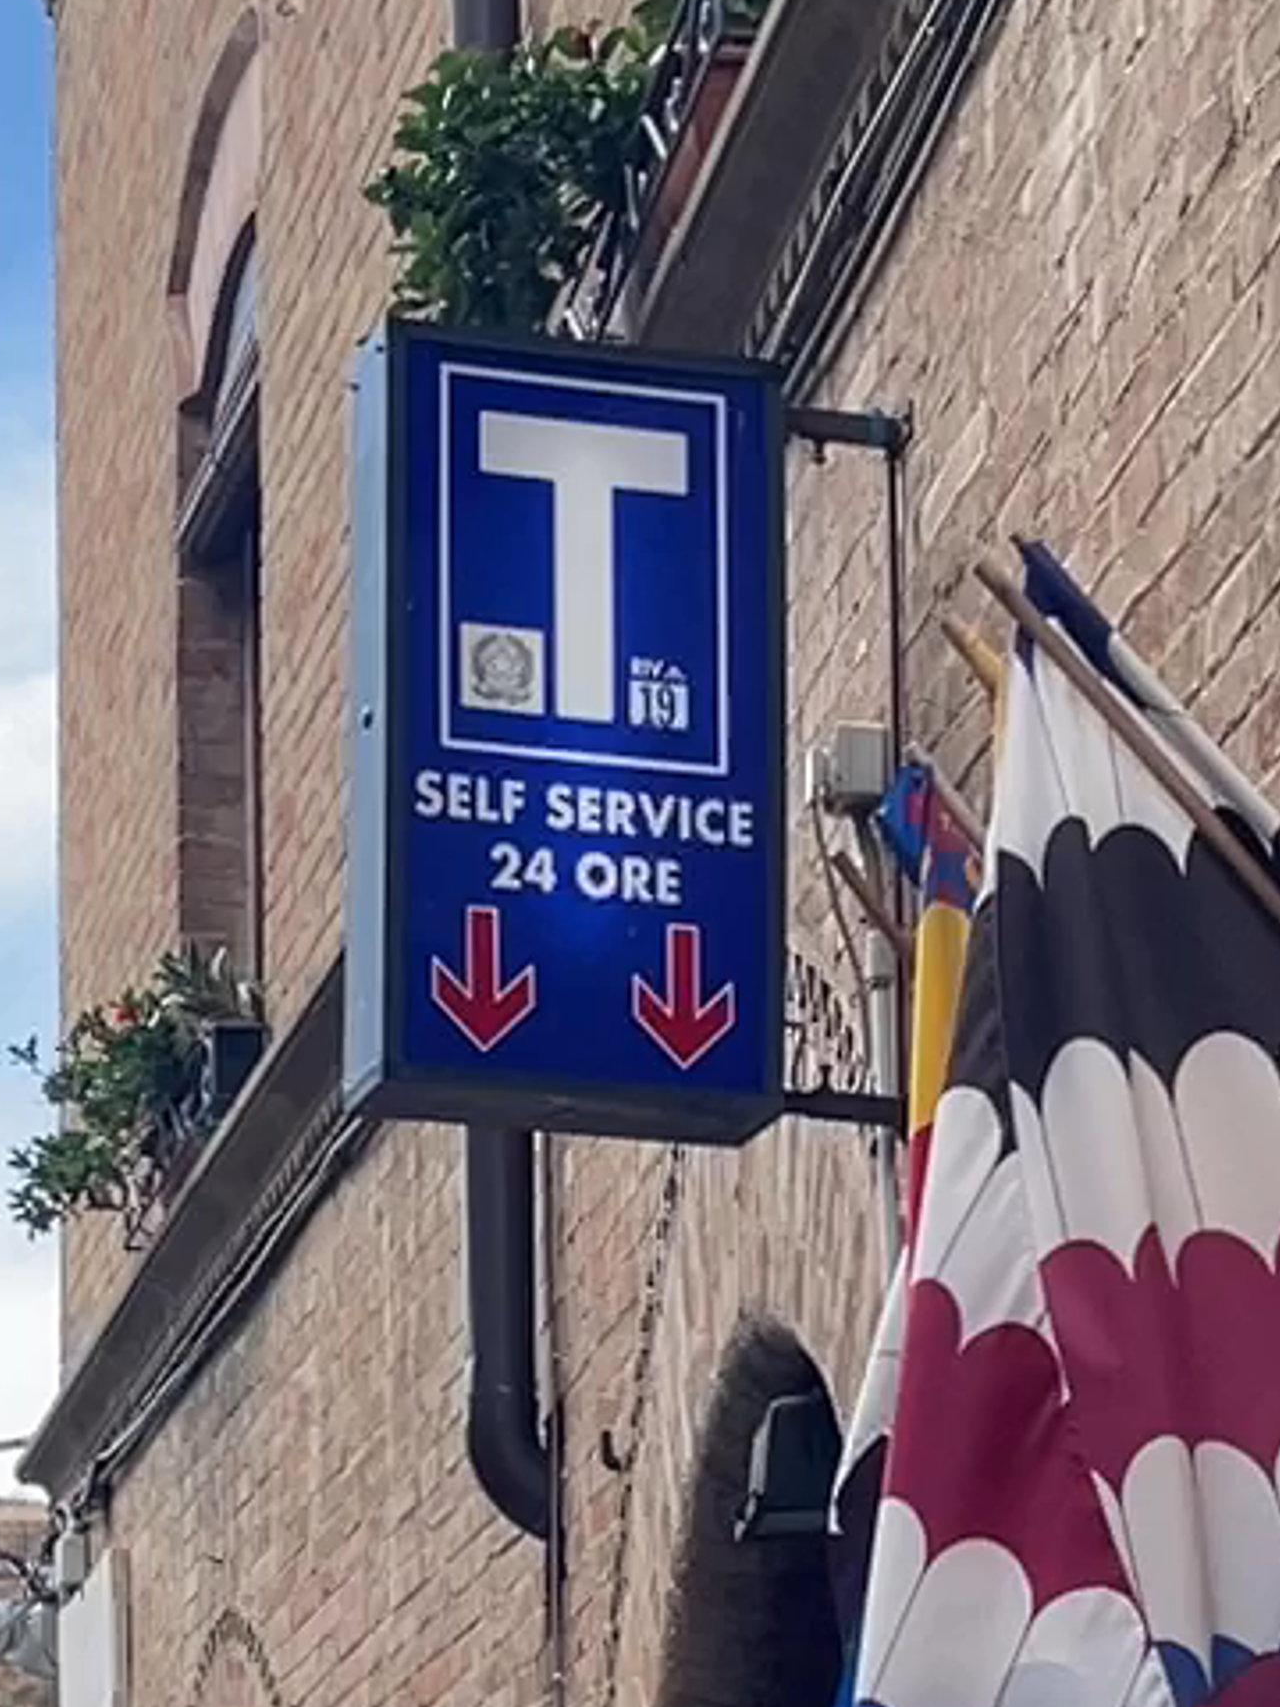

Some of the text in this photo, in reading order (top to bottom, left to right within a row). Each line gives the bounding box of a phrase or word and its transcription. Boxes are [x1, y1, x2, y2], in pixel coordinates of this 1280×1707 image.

[480, 411, 687, 723] T
[638, 686, 676, 726] 19
[414, 769, 753, 845] SELF SERVICE
[489, 842, 682, 905] 24 ORE
